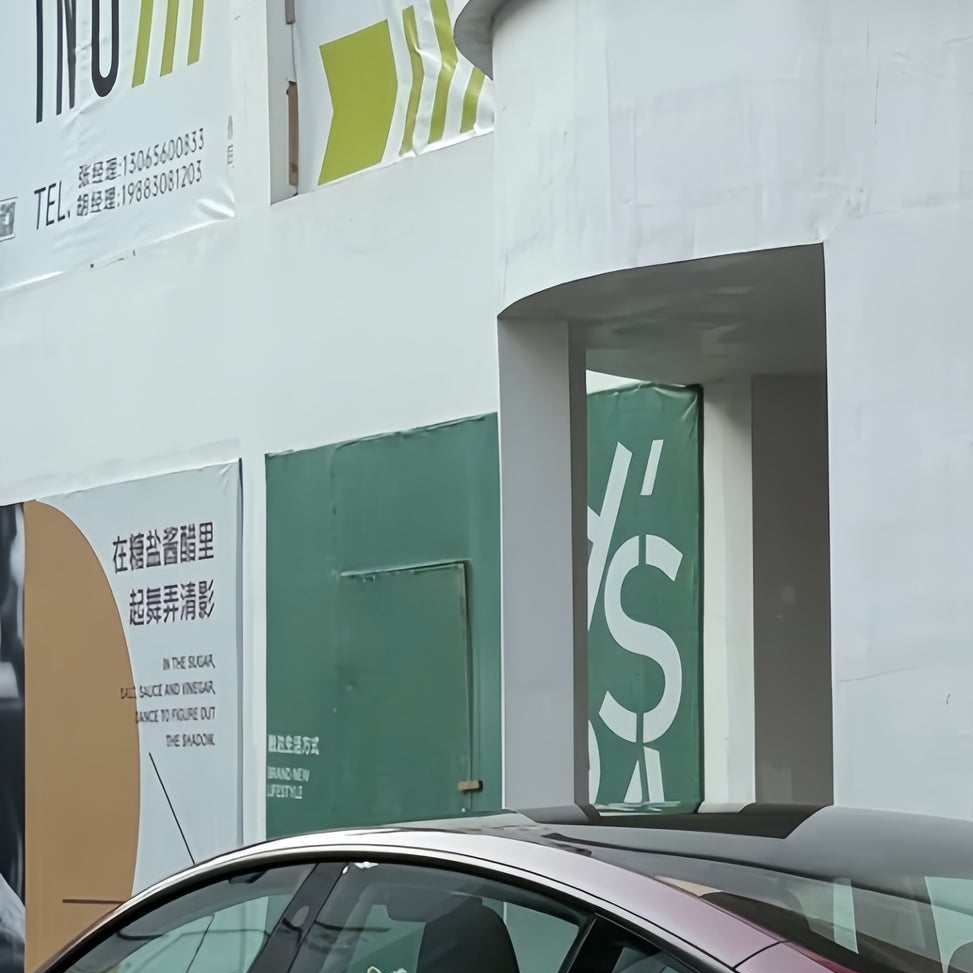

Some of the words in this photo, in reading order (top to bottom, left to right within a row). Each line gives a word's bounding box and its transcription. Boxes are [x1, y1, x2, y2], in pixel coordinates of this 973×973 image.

[112, 521, 215, 574] 在糖盐酱醋里
[129, 579, 215, 626] 起舞弄清影
